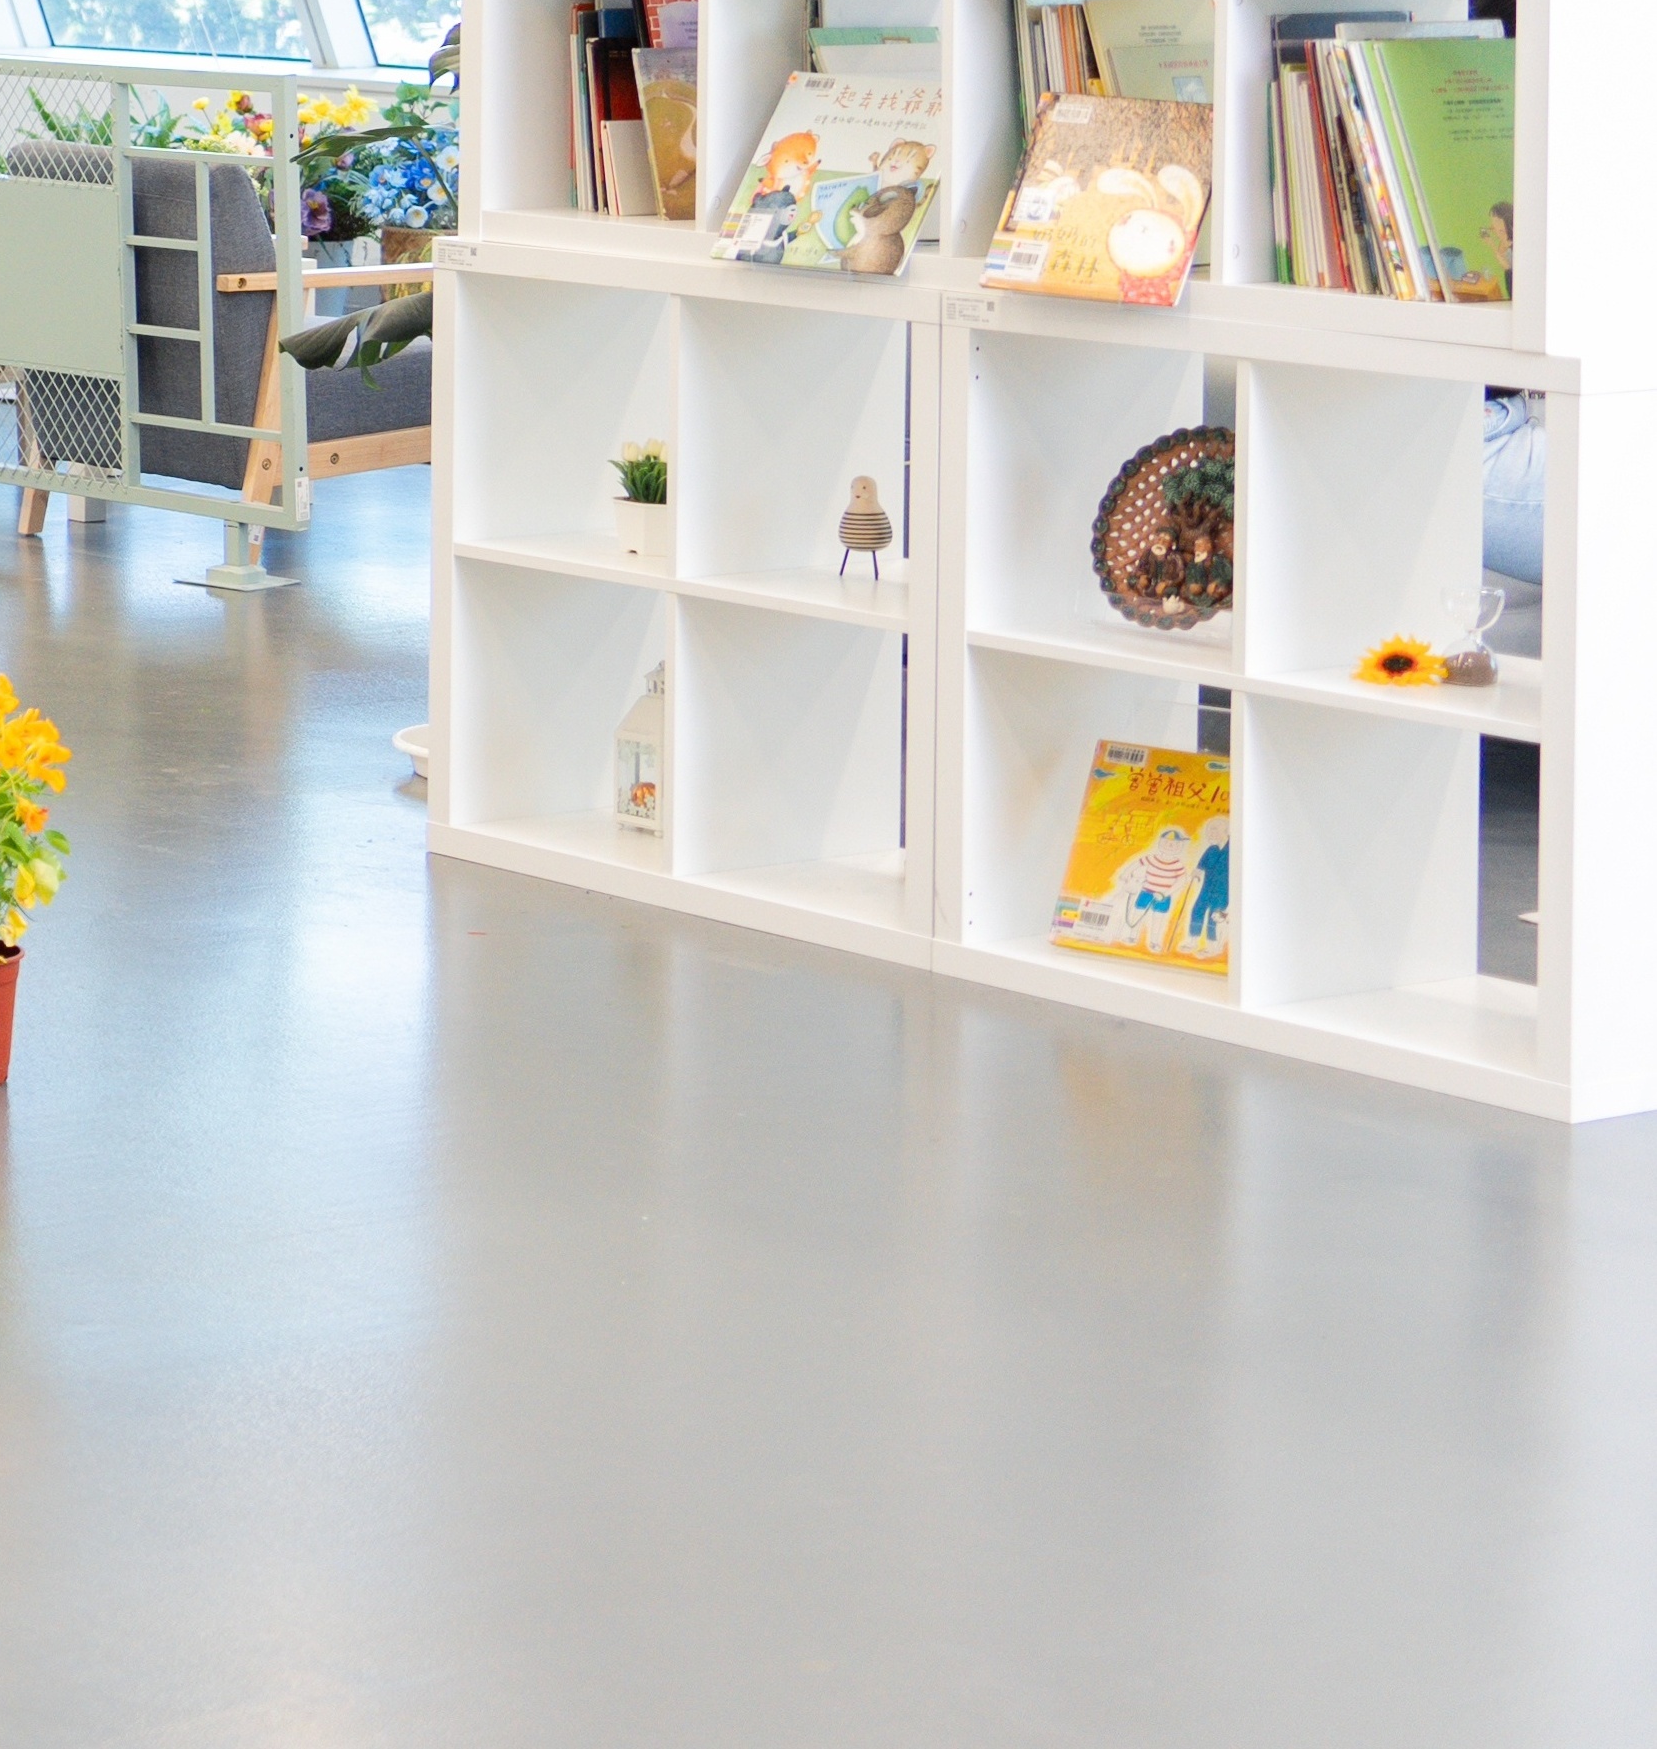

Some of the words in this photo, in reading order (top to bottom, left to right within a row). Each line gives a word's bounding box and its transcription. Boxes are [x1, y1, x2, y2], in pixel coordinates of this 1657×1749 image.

[816, 84, 942, 117] 一起去找爺爺
